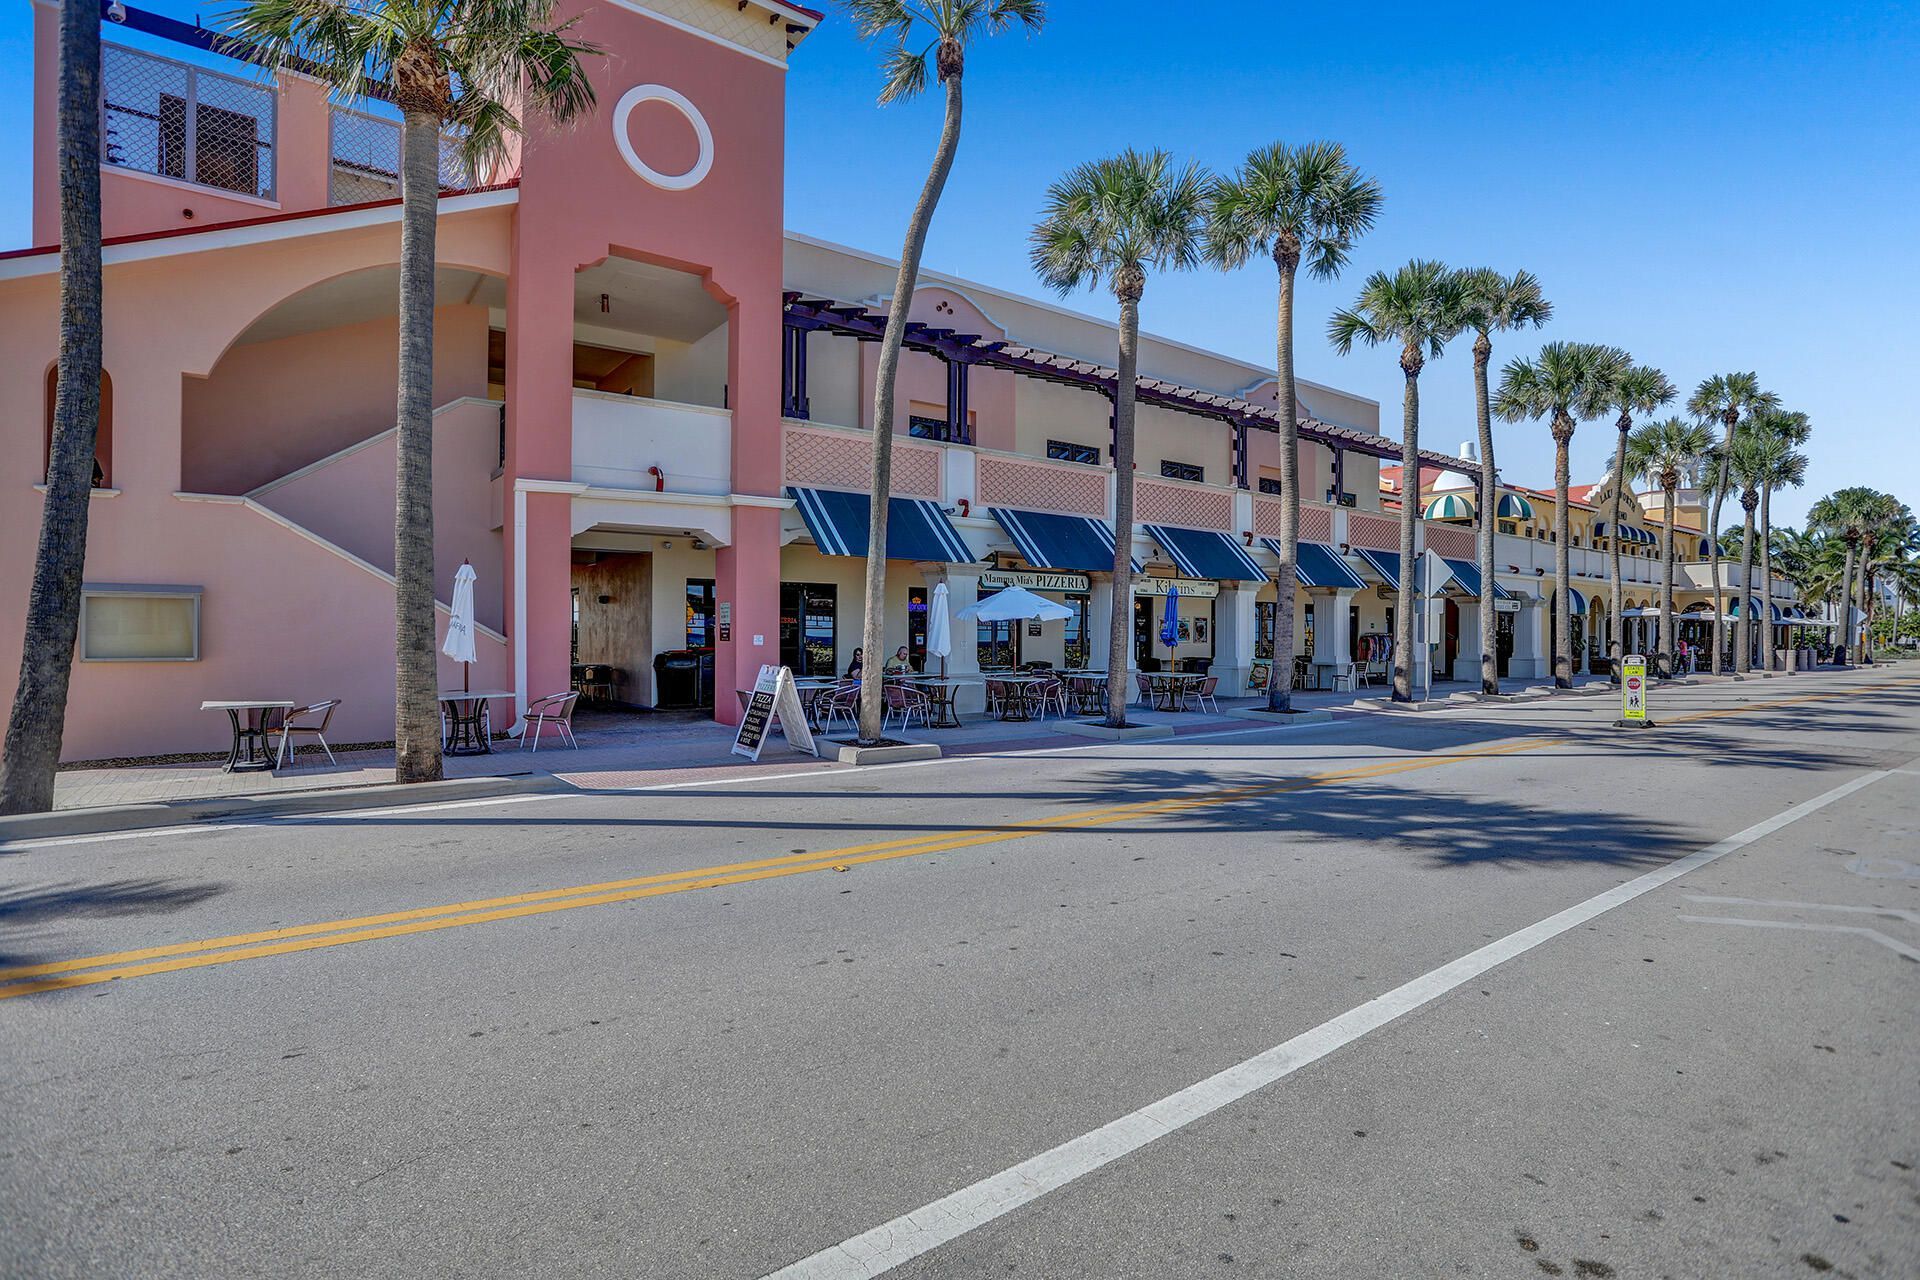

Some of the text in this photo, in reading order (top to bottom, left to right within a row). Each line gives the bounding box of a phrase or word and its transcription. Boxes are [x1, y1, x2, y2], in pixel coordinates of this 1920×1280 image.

[984, 573, 1086, 589] Mamma Mia's PIZZERIA
[754, 693, 773, 704] PIZZA
